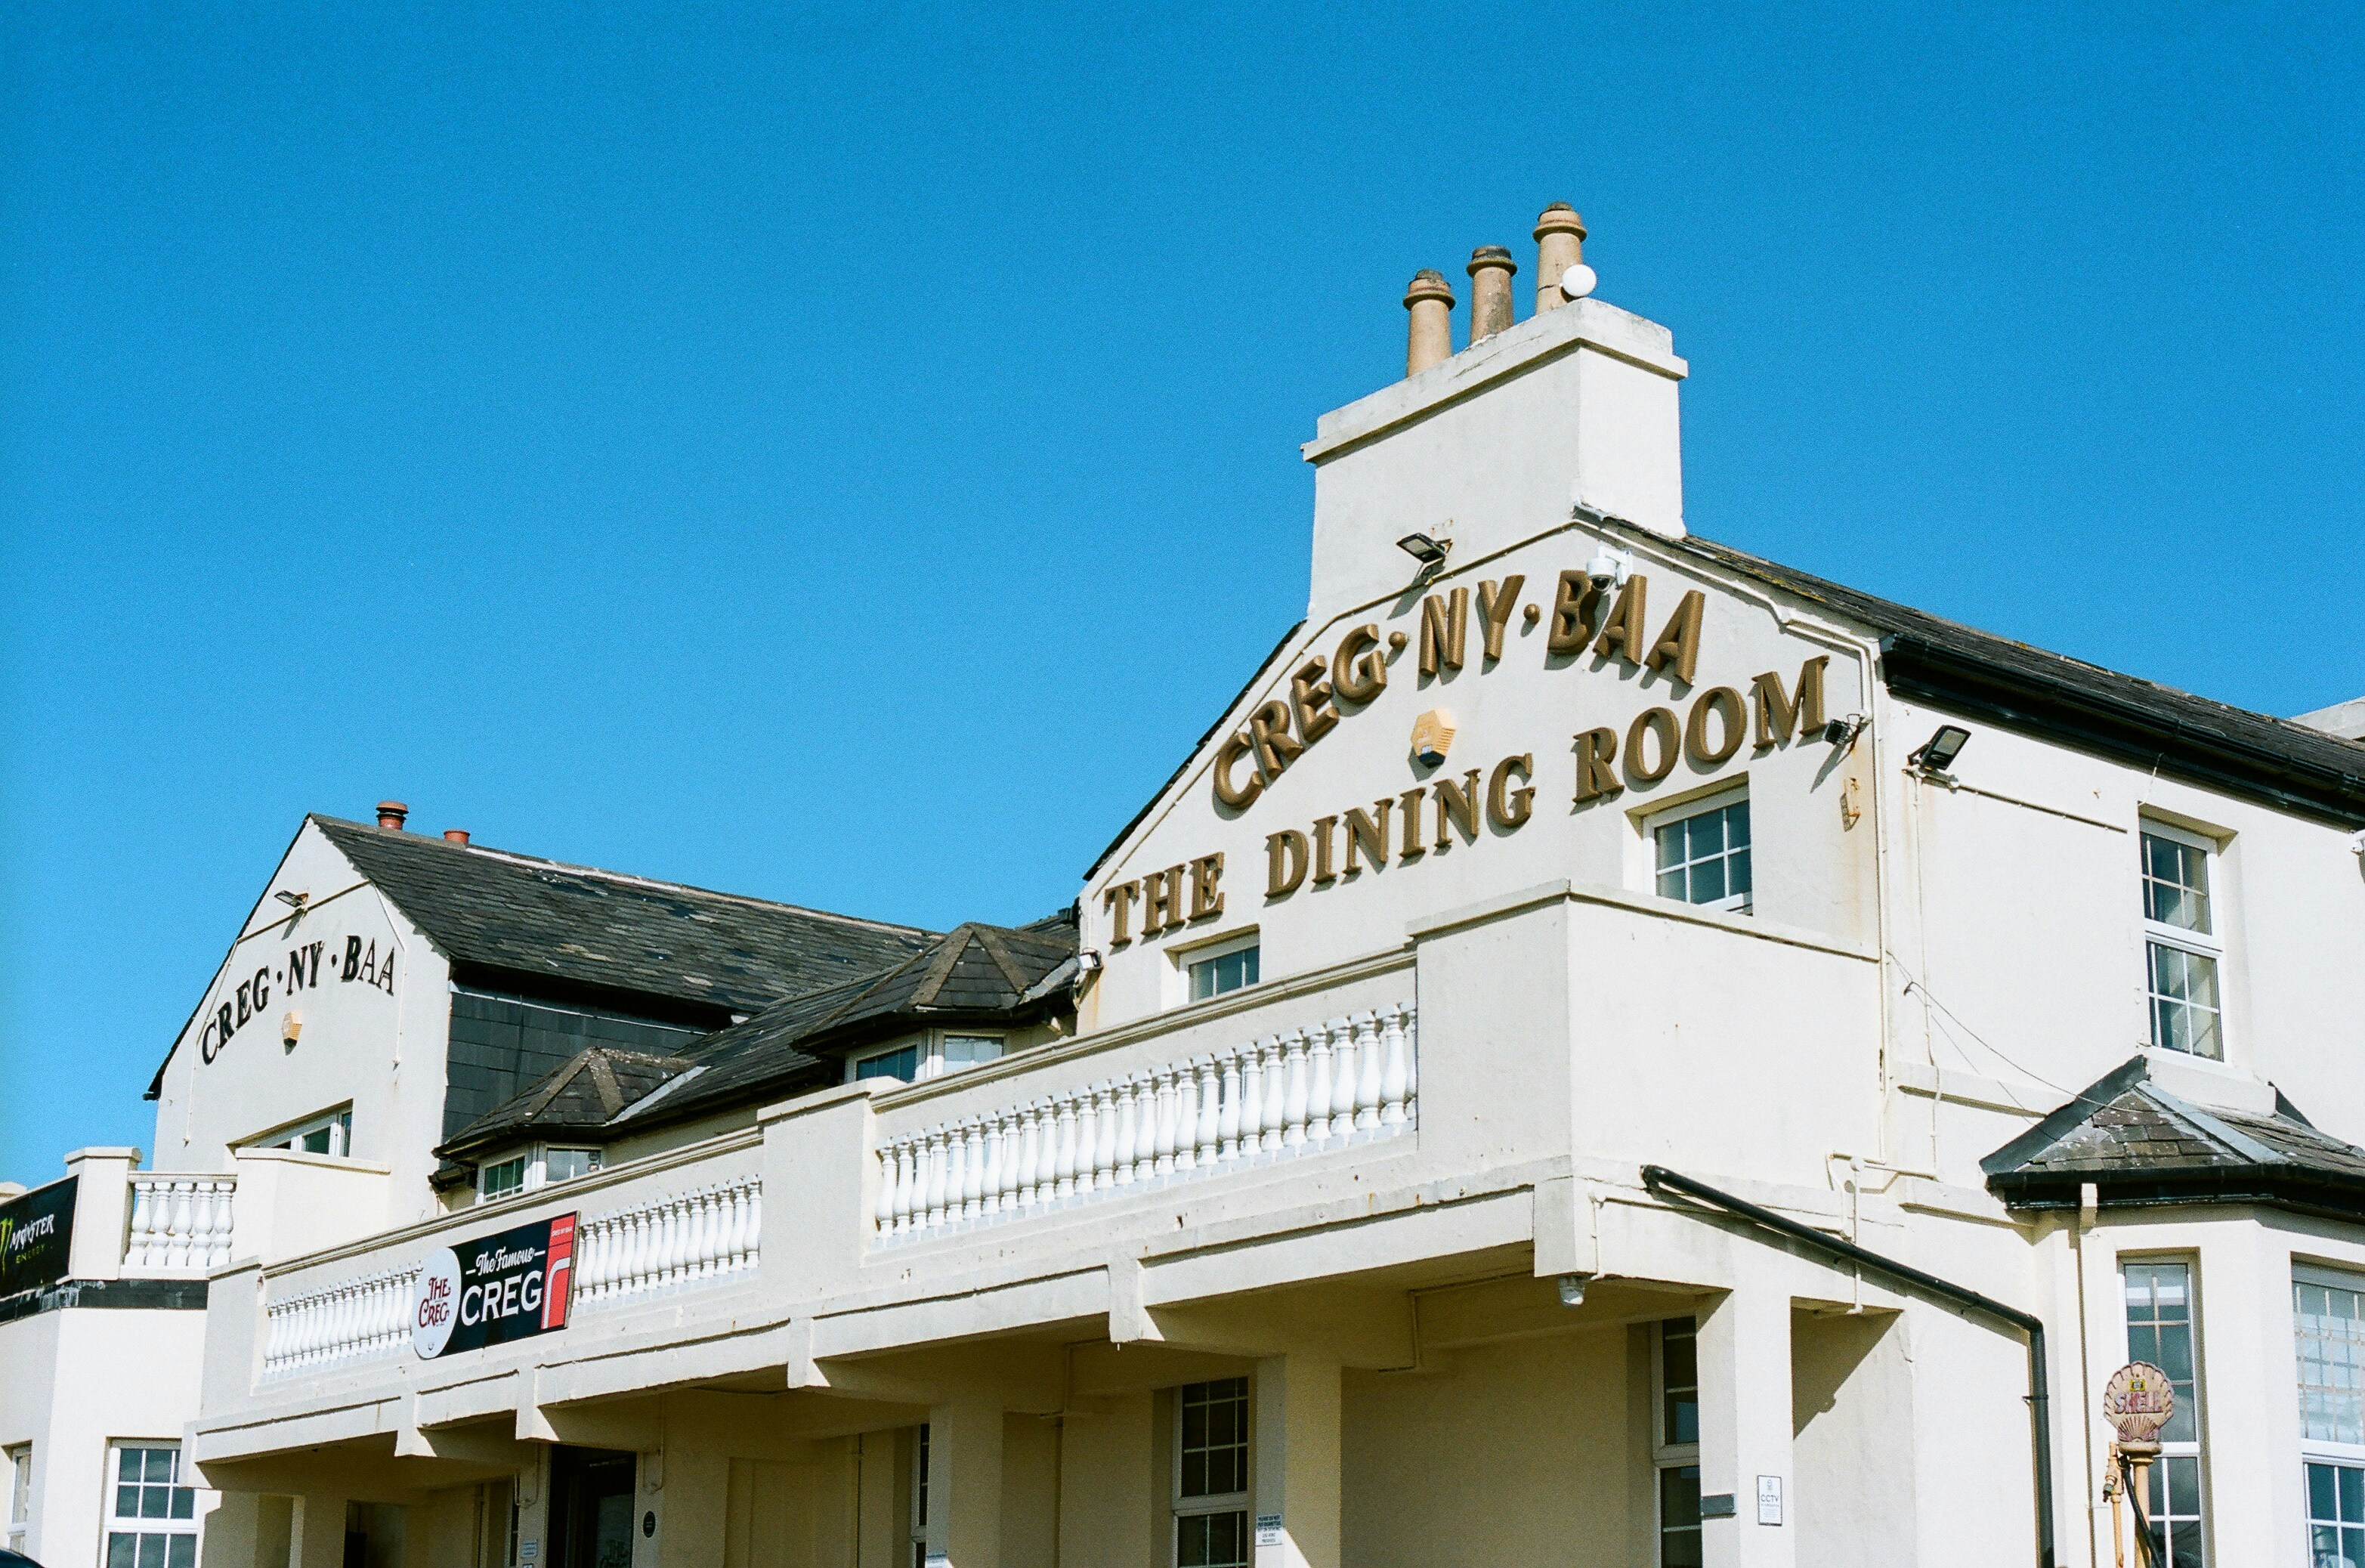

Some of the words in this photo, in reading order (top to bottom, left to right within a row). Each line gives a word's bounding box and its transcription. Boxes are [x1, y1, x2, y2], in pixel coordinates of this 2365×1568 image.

[1213, 623, 1387, 810] CREG
[1418, 574, 1526, 676] NY
[1547, 569, 1705, 684] BAA
[1104, 852, 1224, 947] THE
[1265, 753, 1536, 898] DINING
[1572, 654, 1830, 804] ROOM
[202, 966, 270, 1066] CREG
[286, 940, 326, 996] NY
[341, 935, 395, 997] BAA
[10, 1214, 54, 1251] MONSTER
[475, 1251, 496, 1276] The
[495, 1246, 535, 1271] Famous
[428, 1276, 451, 1300] THE
[462, 1270, 543, 1325] CREG
[419, 1297, 450, 1328] CREG
[2114, 1391, 2164, 1414] SHELL
